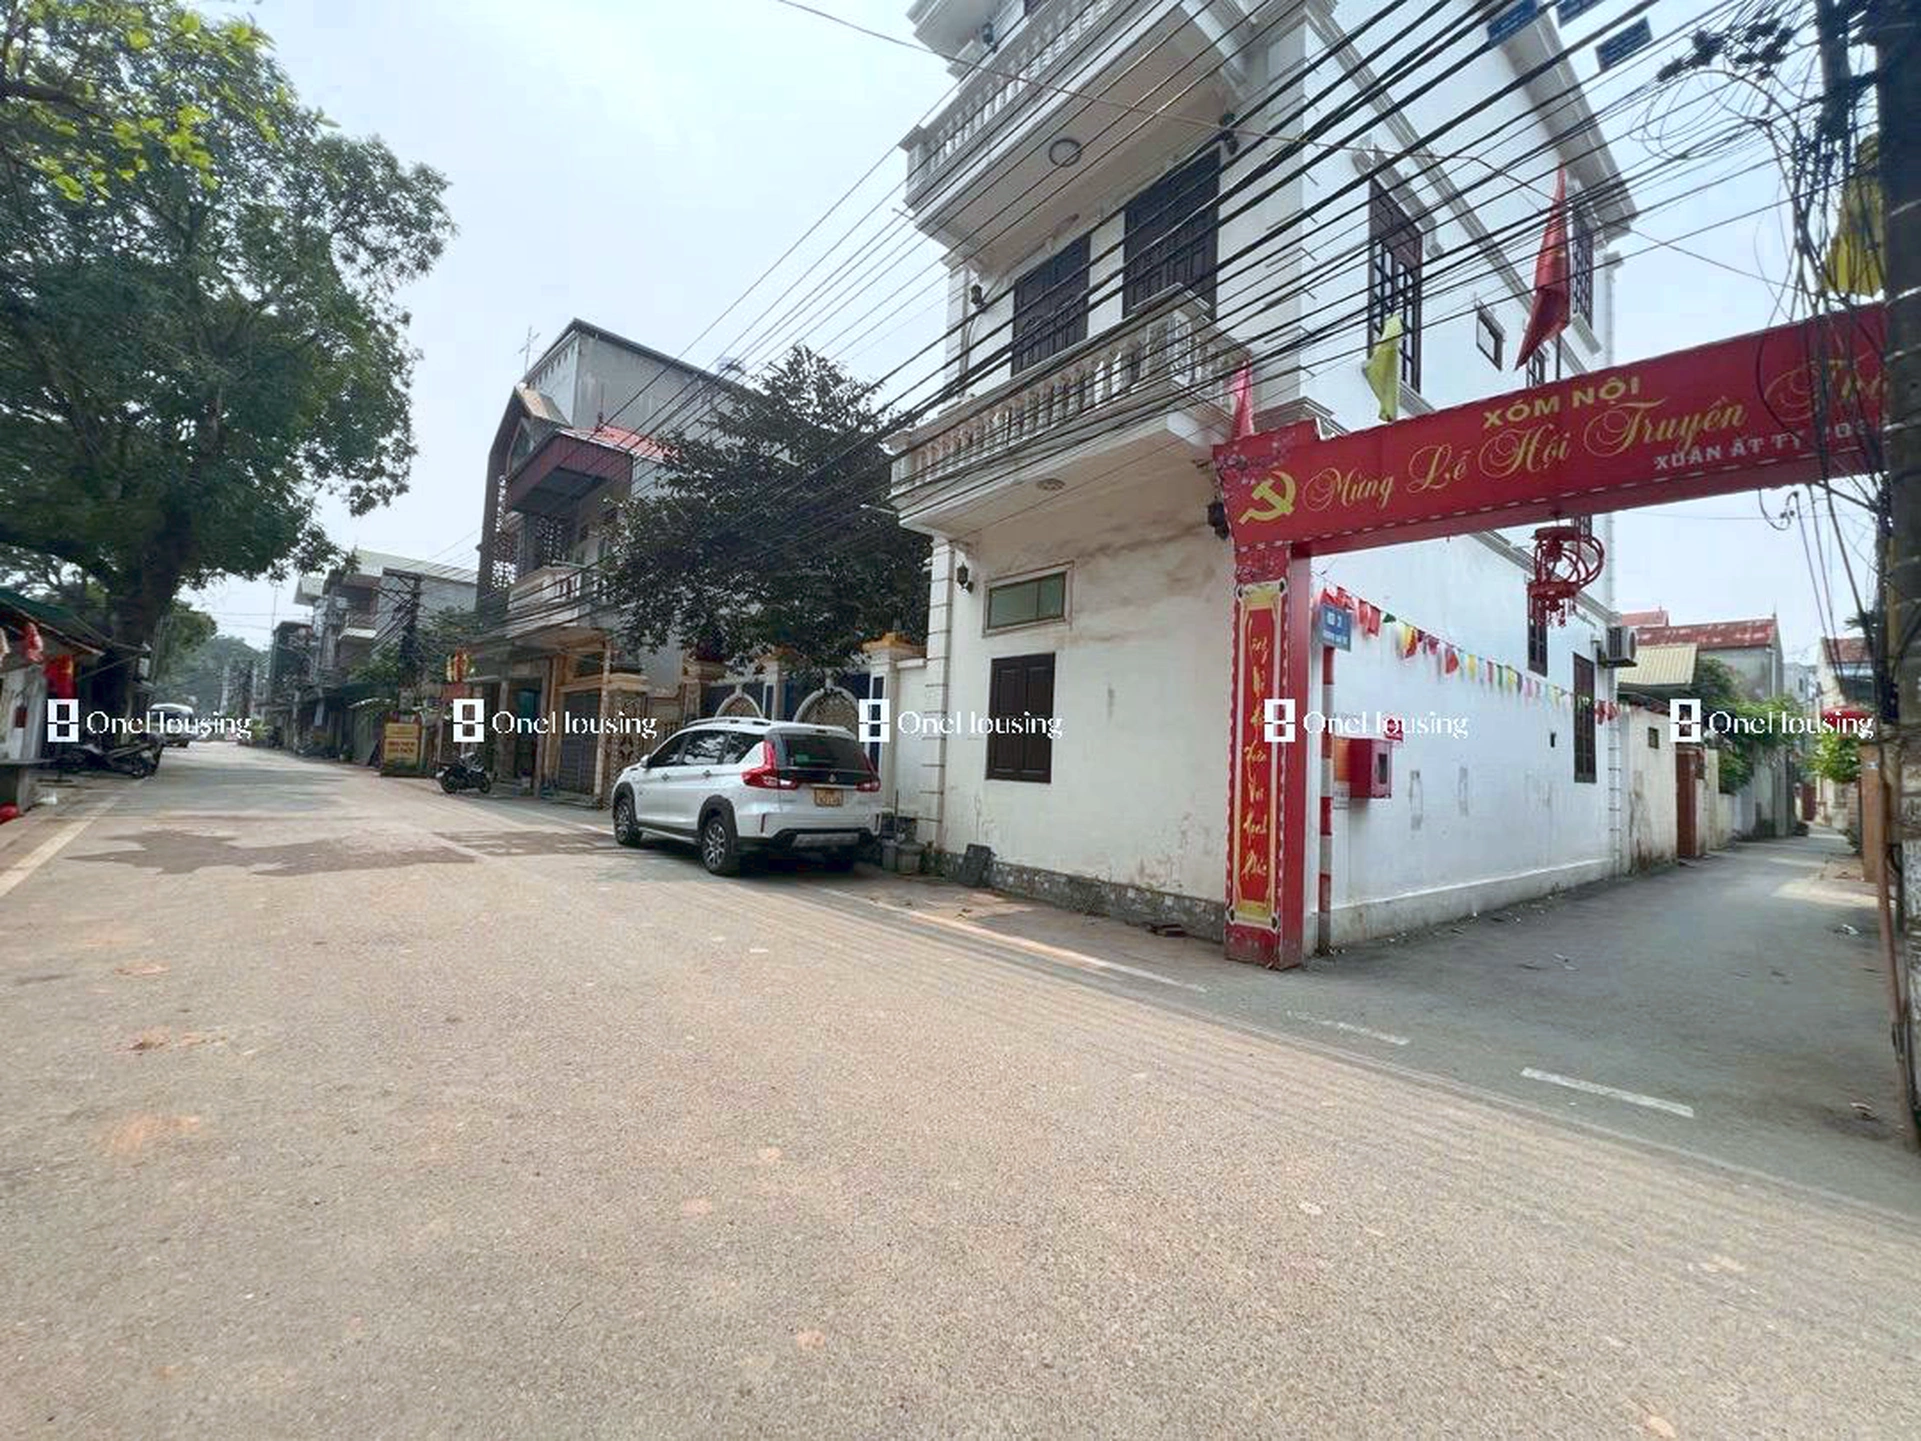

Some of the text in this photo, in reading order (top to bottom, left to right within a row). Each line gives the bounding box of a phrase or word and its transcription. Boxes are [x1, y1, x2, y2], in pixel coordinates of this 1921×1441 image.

[1482, 395, 1560, 428] XÓM
[1303, 395, 1748, 511] Mừng Lễ Hội Truyền
